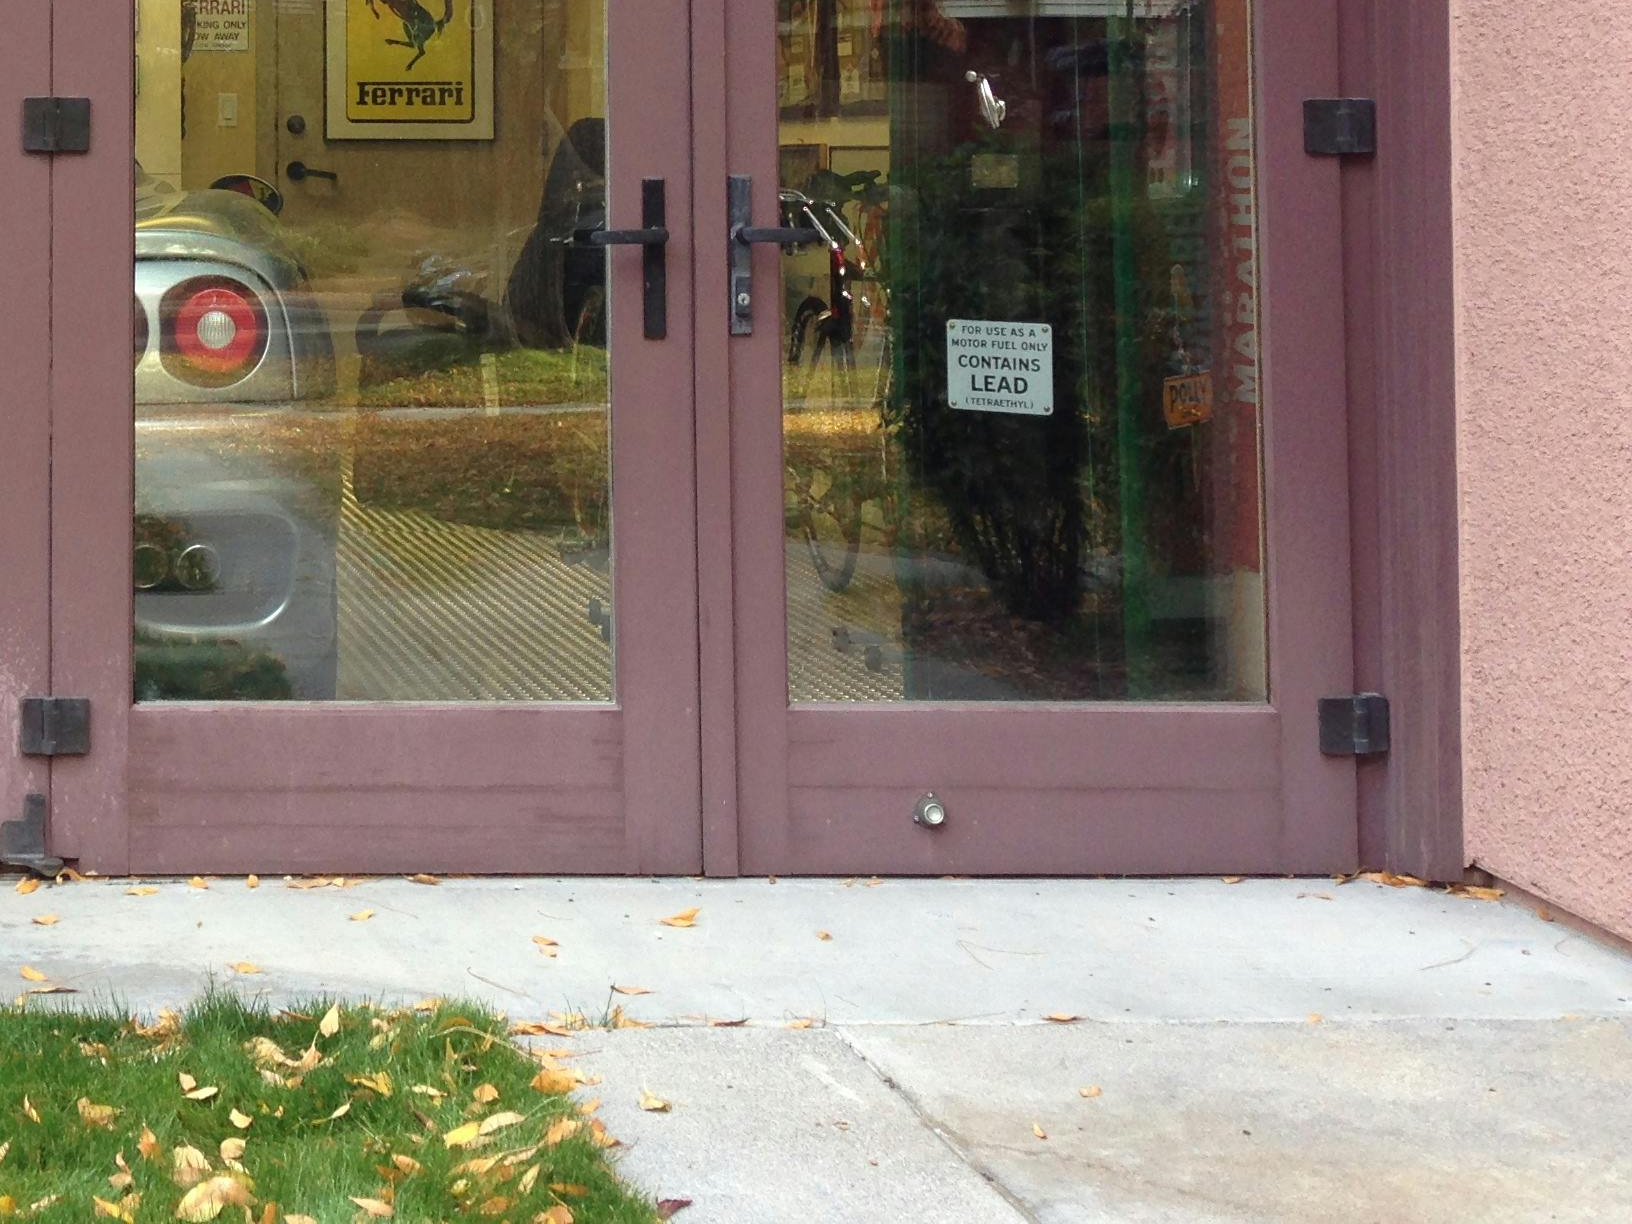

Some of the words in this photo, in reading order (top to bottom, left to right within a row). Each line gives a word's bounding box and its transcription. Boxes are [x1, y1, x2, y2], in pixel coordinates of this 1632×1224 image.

[223, 21, 246, 30] ONLY
[356, 81, 464, 106] Ferrari
[1226, 117, 1257, 405] MARATHON
[961, 325, 982, 336] FOR
[986, 326, 1007, 337] USE
[1010, 328, 1025, 338] AS
[1028, 329, 1037, 338] A
[951, 338, 988, 349] MOTOR
[991, 340, 1018, 350] FUEL
[1021, 342, 1048, 352] ONLY
[958, 354, 1041, 373] CONTAINS
[970, 374, 1028, 394] LEAD
